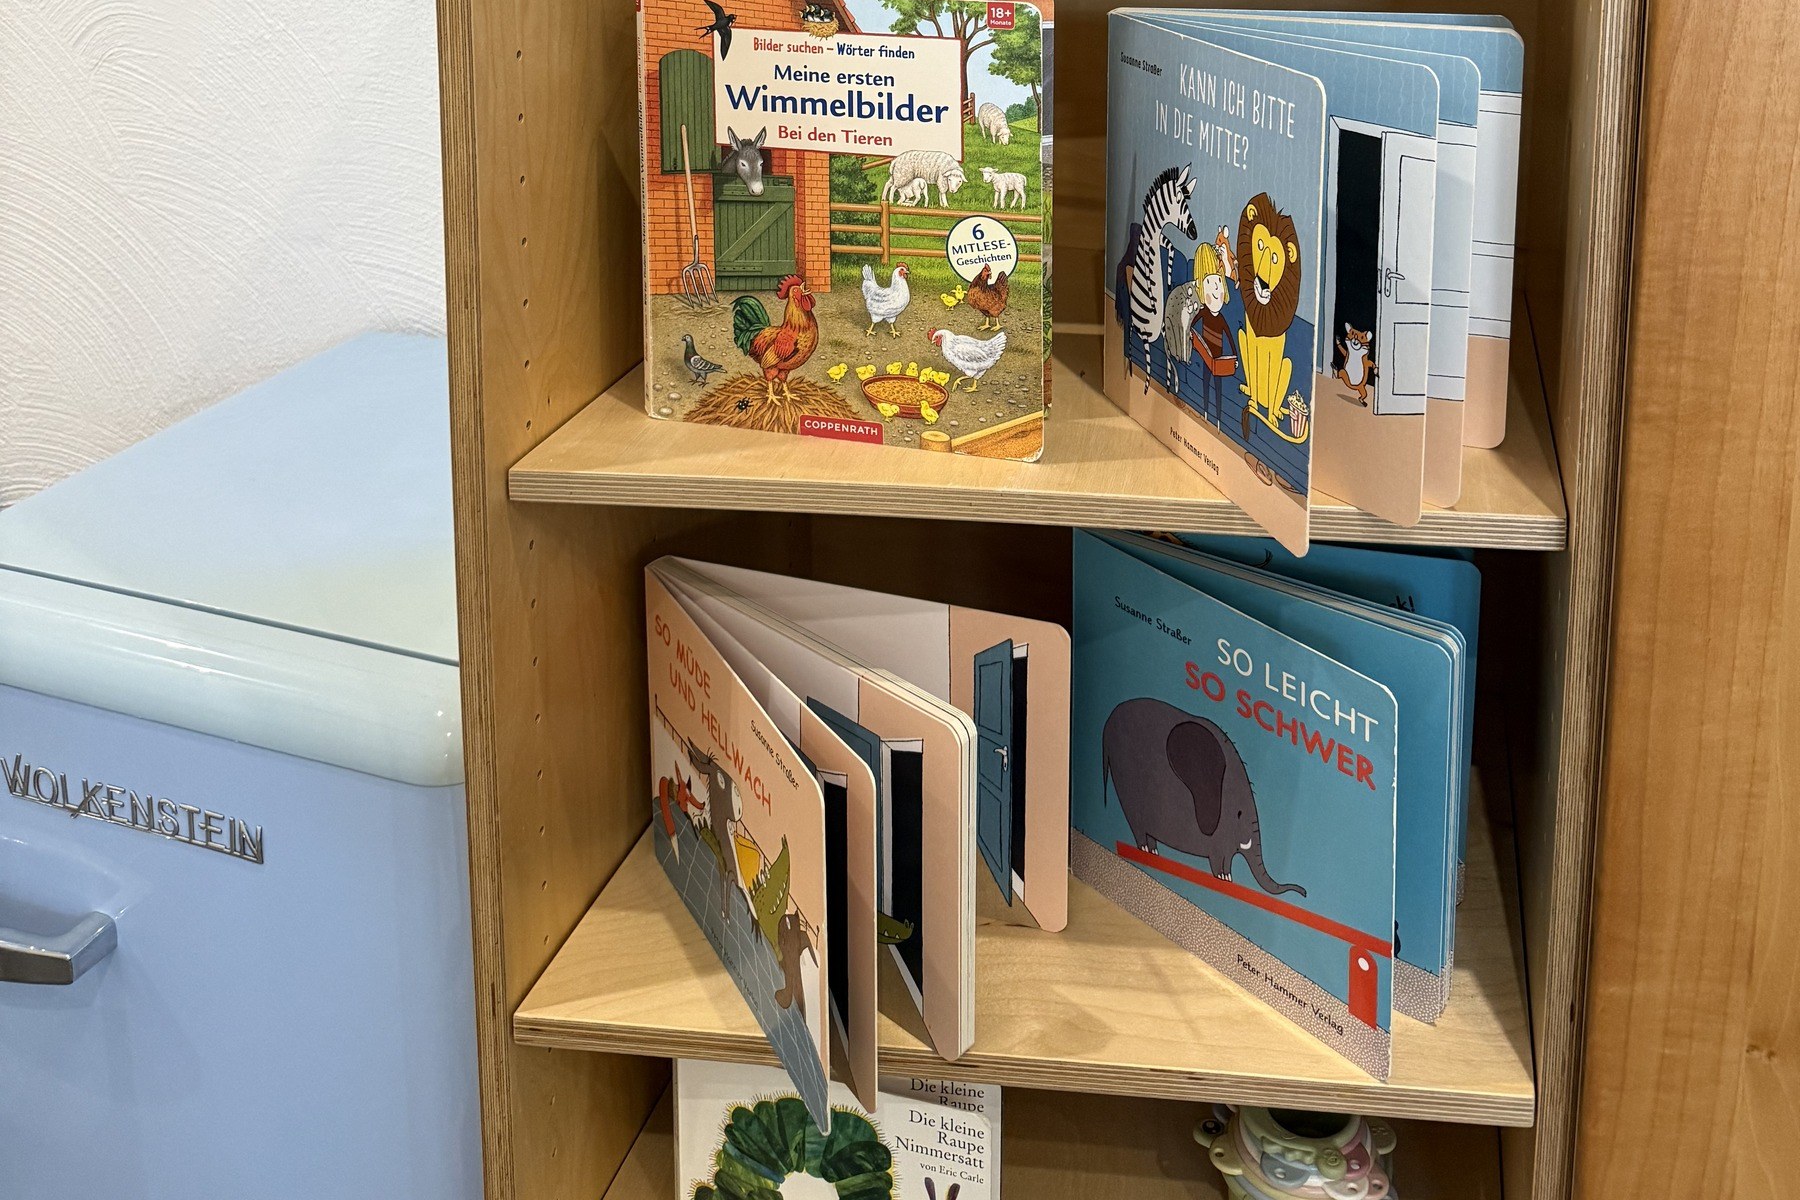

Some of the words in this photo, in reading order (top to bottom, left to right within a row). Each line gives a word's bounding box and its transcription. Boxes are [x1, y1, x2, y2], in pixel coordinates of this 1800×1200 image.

[990, 7, 1012, 19] 18+
[753, 36, 784, 52] Bilder
[786, 42, 824, 55] suchen
[836, 41, 876, 58] Wörter
[877, 44, 916, 60] finden
[774, 64, 831, 84] Meine
[836, 71, 896, 88] ersten
[1120, 51, 1142, 70] Susanne
[1142, 59, 1163, 77] Straßer
[725, 84, 950, 125] Wimmelbilder
[1179, 63, 1217, 109] KANN
[1223, 78, 1246, 119] ICH
[1252, 89, 1296, 140] BITTE
[778, 125, 802, 141] Bei
[807, 126, 837, 144] den
[841, 128, 894, 147] Tieren
[1155, 99, 1169, 136] IN
[1173, 107, 1194, 147] DIE
[1199, 119, 1250, 171] MITTE?
[951, 238, 1011, 256] MITLESE-
[972, 223, 985, 240] 6
[956, 253, 1012, 266] Geschichten
[804, 419, 879, 436] COPPENRATH
[1114, 595, 1153, 626] Susanne
[1156, 617, 1192, 646] Straßer
[654, 614, 671, 647] SO
[676, 638, 711, 700] MÜDE
[1216, 637, 1254, 678] SO
[1264, 661, 1380, 744] LEICHT
[669, 662, 697, 713] UND
[701, 701, 772, 817] HELLWACH
[750, 718, 775, 759] Susanne
[1184, 660, 1227, 703] SO
[1235, 688, 1377, 792] SCHWER
[0, 752, 264, 865] WOLKENSTEIN
[1236, 953, 1260, 977] Peter
[1264, 972, 1307, 1009] Hammer
[1311, 1003, 1344, 1036] Verlag
[909, 1078, 937, 1093] Die
[940, 1080, 986, 1099] kleine
[908, 1109, 937, 1128] Die
[940, 1115, 986, 1140] kleine
[894, 1135, 985, 1170] Nimmersatt
[937, 1130, 986, 1155] Raupe
[919, 1162, 938, 1173] von
[939, 1165, 958, 1178] Eric
[959, 1170, 985, 1185] Carle
